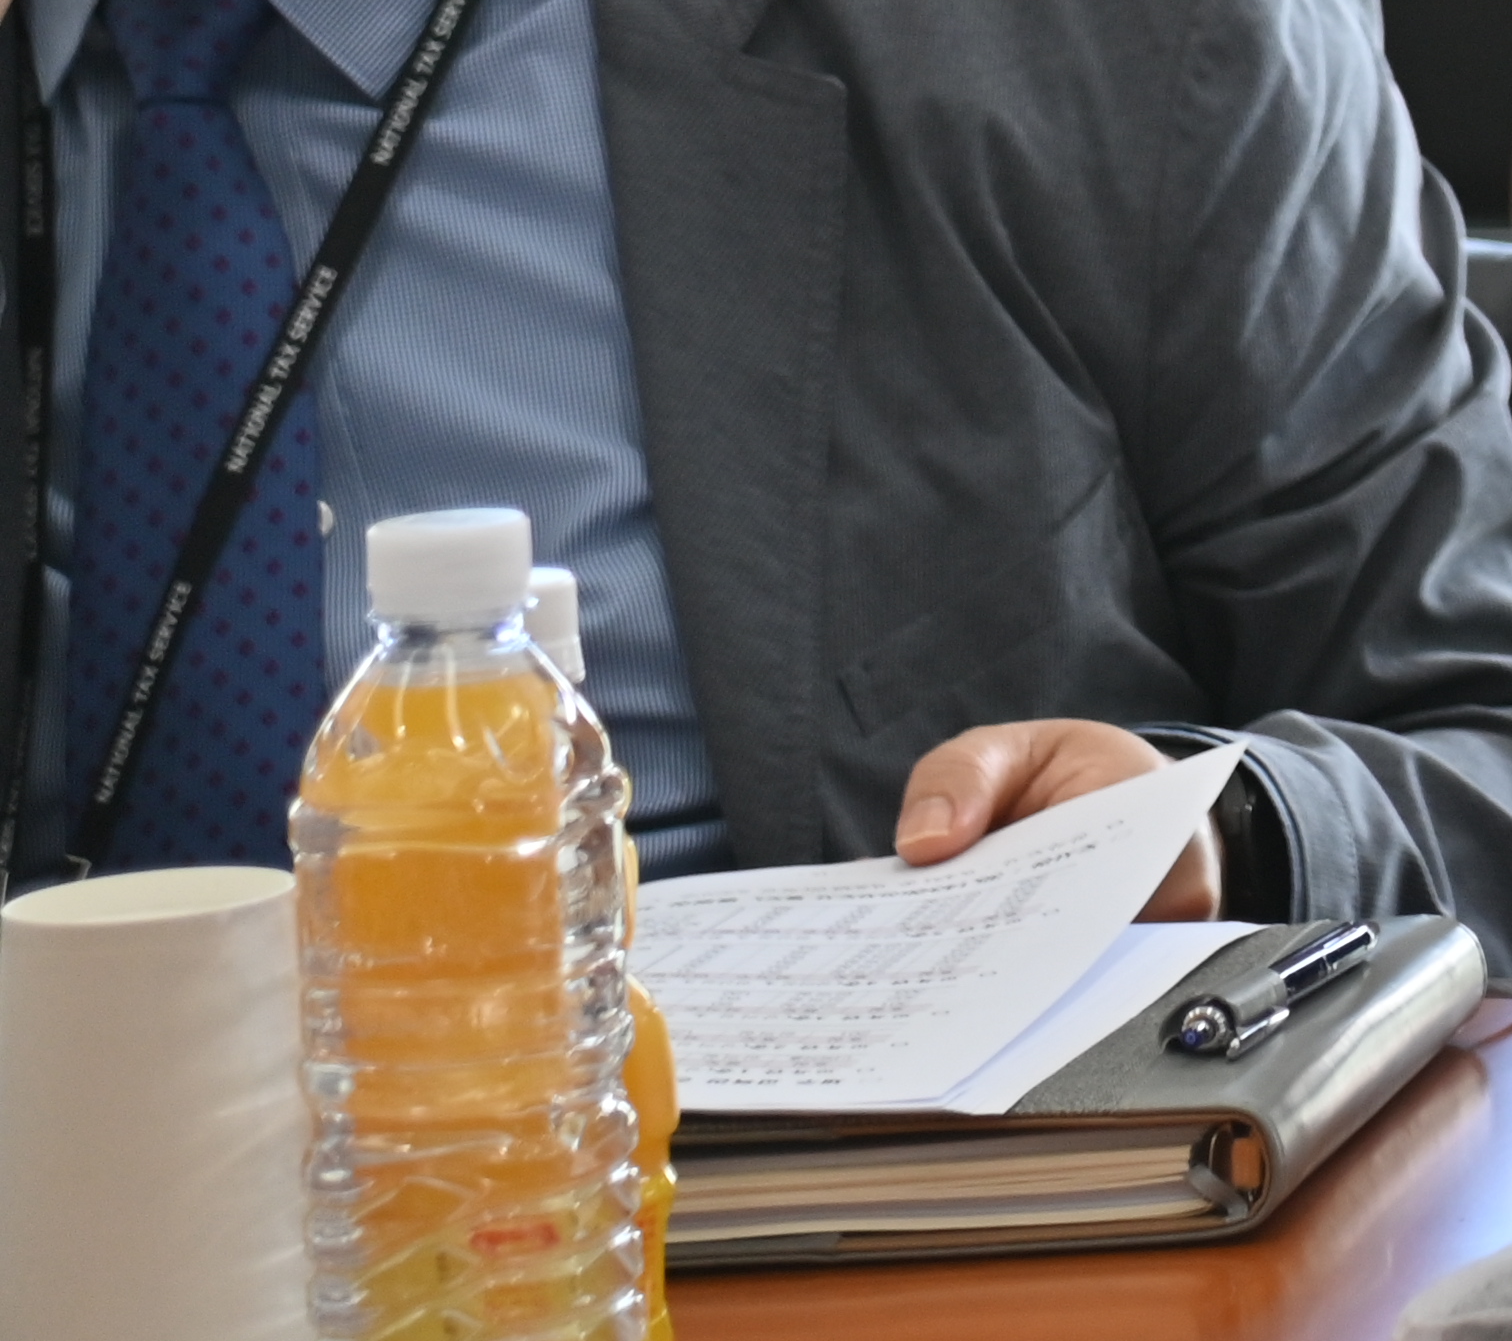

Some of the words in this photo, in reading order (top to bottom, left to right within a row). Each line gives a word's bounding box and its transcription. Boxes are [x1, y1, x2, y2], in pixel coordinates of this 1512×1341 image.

[370, 77, 428, 166] NATIONAL
[413, 39, 446, 75] TAX
[226, 383, 283, 473] NATIONAL
[268, 341, 301, 380] TAX
[286, 264, 338, 343] SERVICE
[95, 709, 144, 804] NATIONAL
[133, 666, 159, 703] TAX
[147, 580, 193, 662] SERVICE
